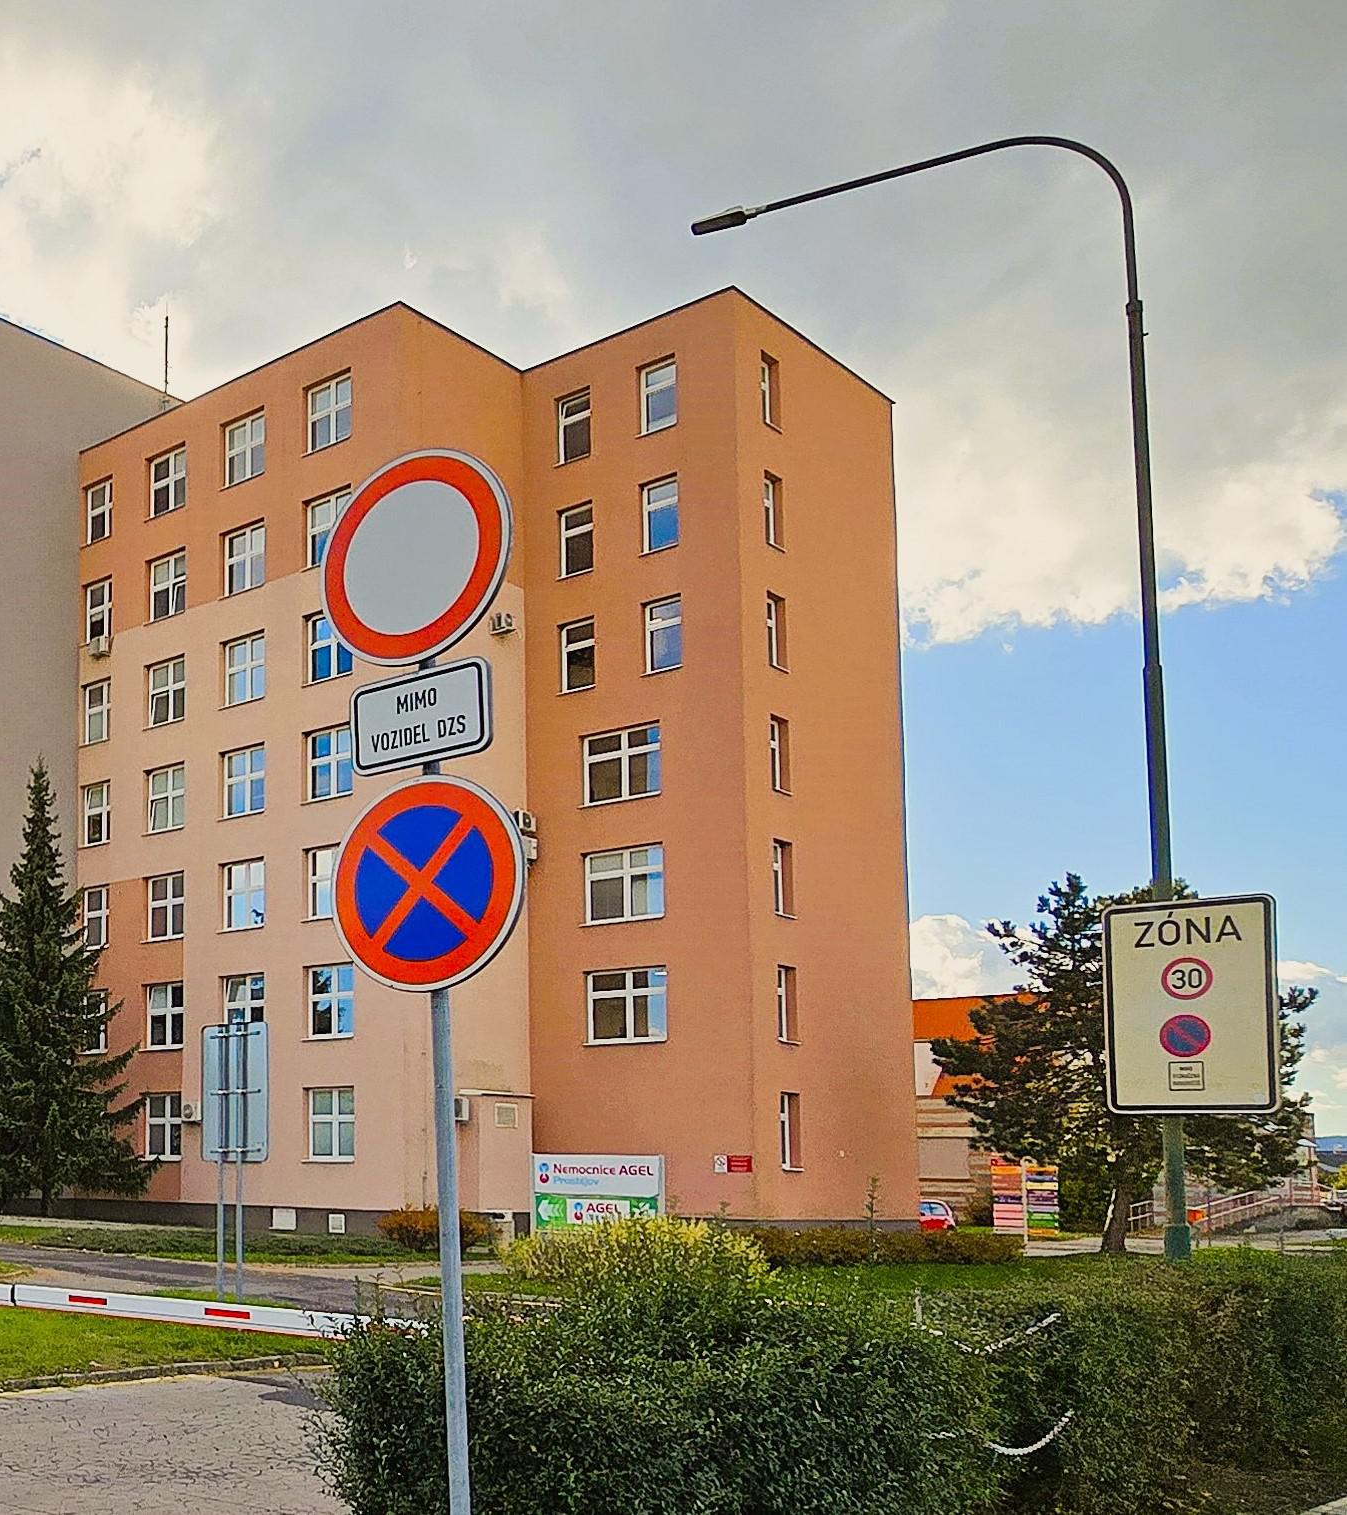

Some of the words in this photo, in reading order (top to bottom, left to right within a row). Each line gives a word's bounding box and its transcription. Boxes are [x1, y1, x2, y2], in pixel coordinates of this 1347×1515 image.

[396, 687, 437, 714] MIMO
[371, 723, 430, 752] VOZIDEL
[437, 715, 466, 739] DZS
[1134, 911, 1242, 948] ZÓNA
[1171, 968, 1203, 989] 30
[553, 1163, 616, 1175] Nemocnice
[619, 1165, 654, 1176] AGEL
[586, 1203, 622, 1214] AGEL
